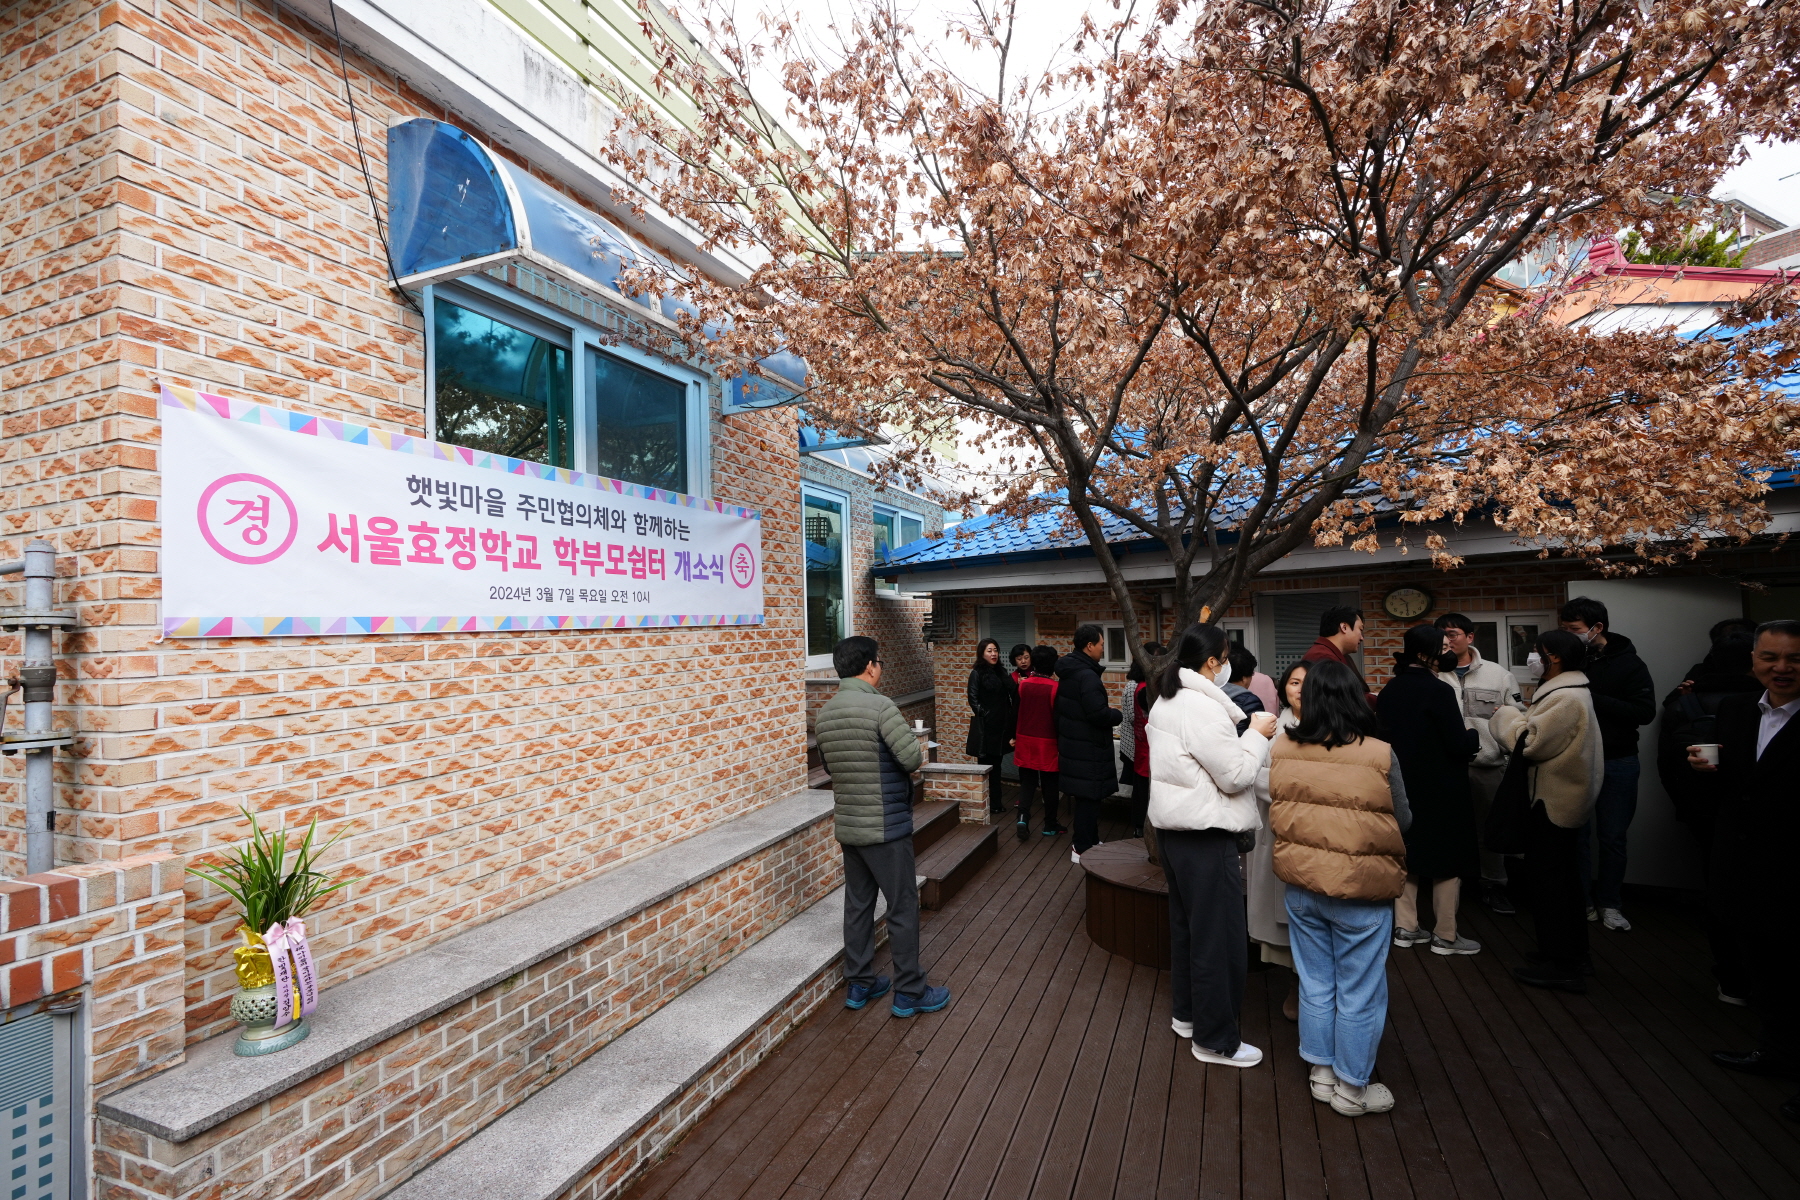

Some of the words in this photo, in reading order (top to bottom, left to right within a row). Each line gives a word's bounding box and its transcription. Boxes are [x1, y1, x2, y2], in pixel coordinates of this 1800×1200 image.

[223, 494, 271, 546] 경
[405, 474, 507, 518] 햇빛마을
[516, 493, 627, 534] 주민협의체와
[633, 511, 691, 542] 함께하는
[316, 512, 542, 573] 서울효정학교
[552, 536, 666, 581] 학부모쉼터
[674, 550, 724, 584] 개소식
[735, 552, 751, 580] 축
[489, 585, 532, 602] 2024년
[536, 587, 554, 603] 3월
[558, 588, 575, 603] 7일
[579, 588, 607, 604] 목요일
[611, 589, 629, 603] 오전
[632, 590, 651, 604] 10시
